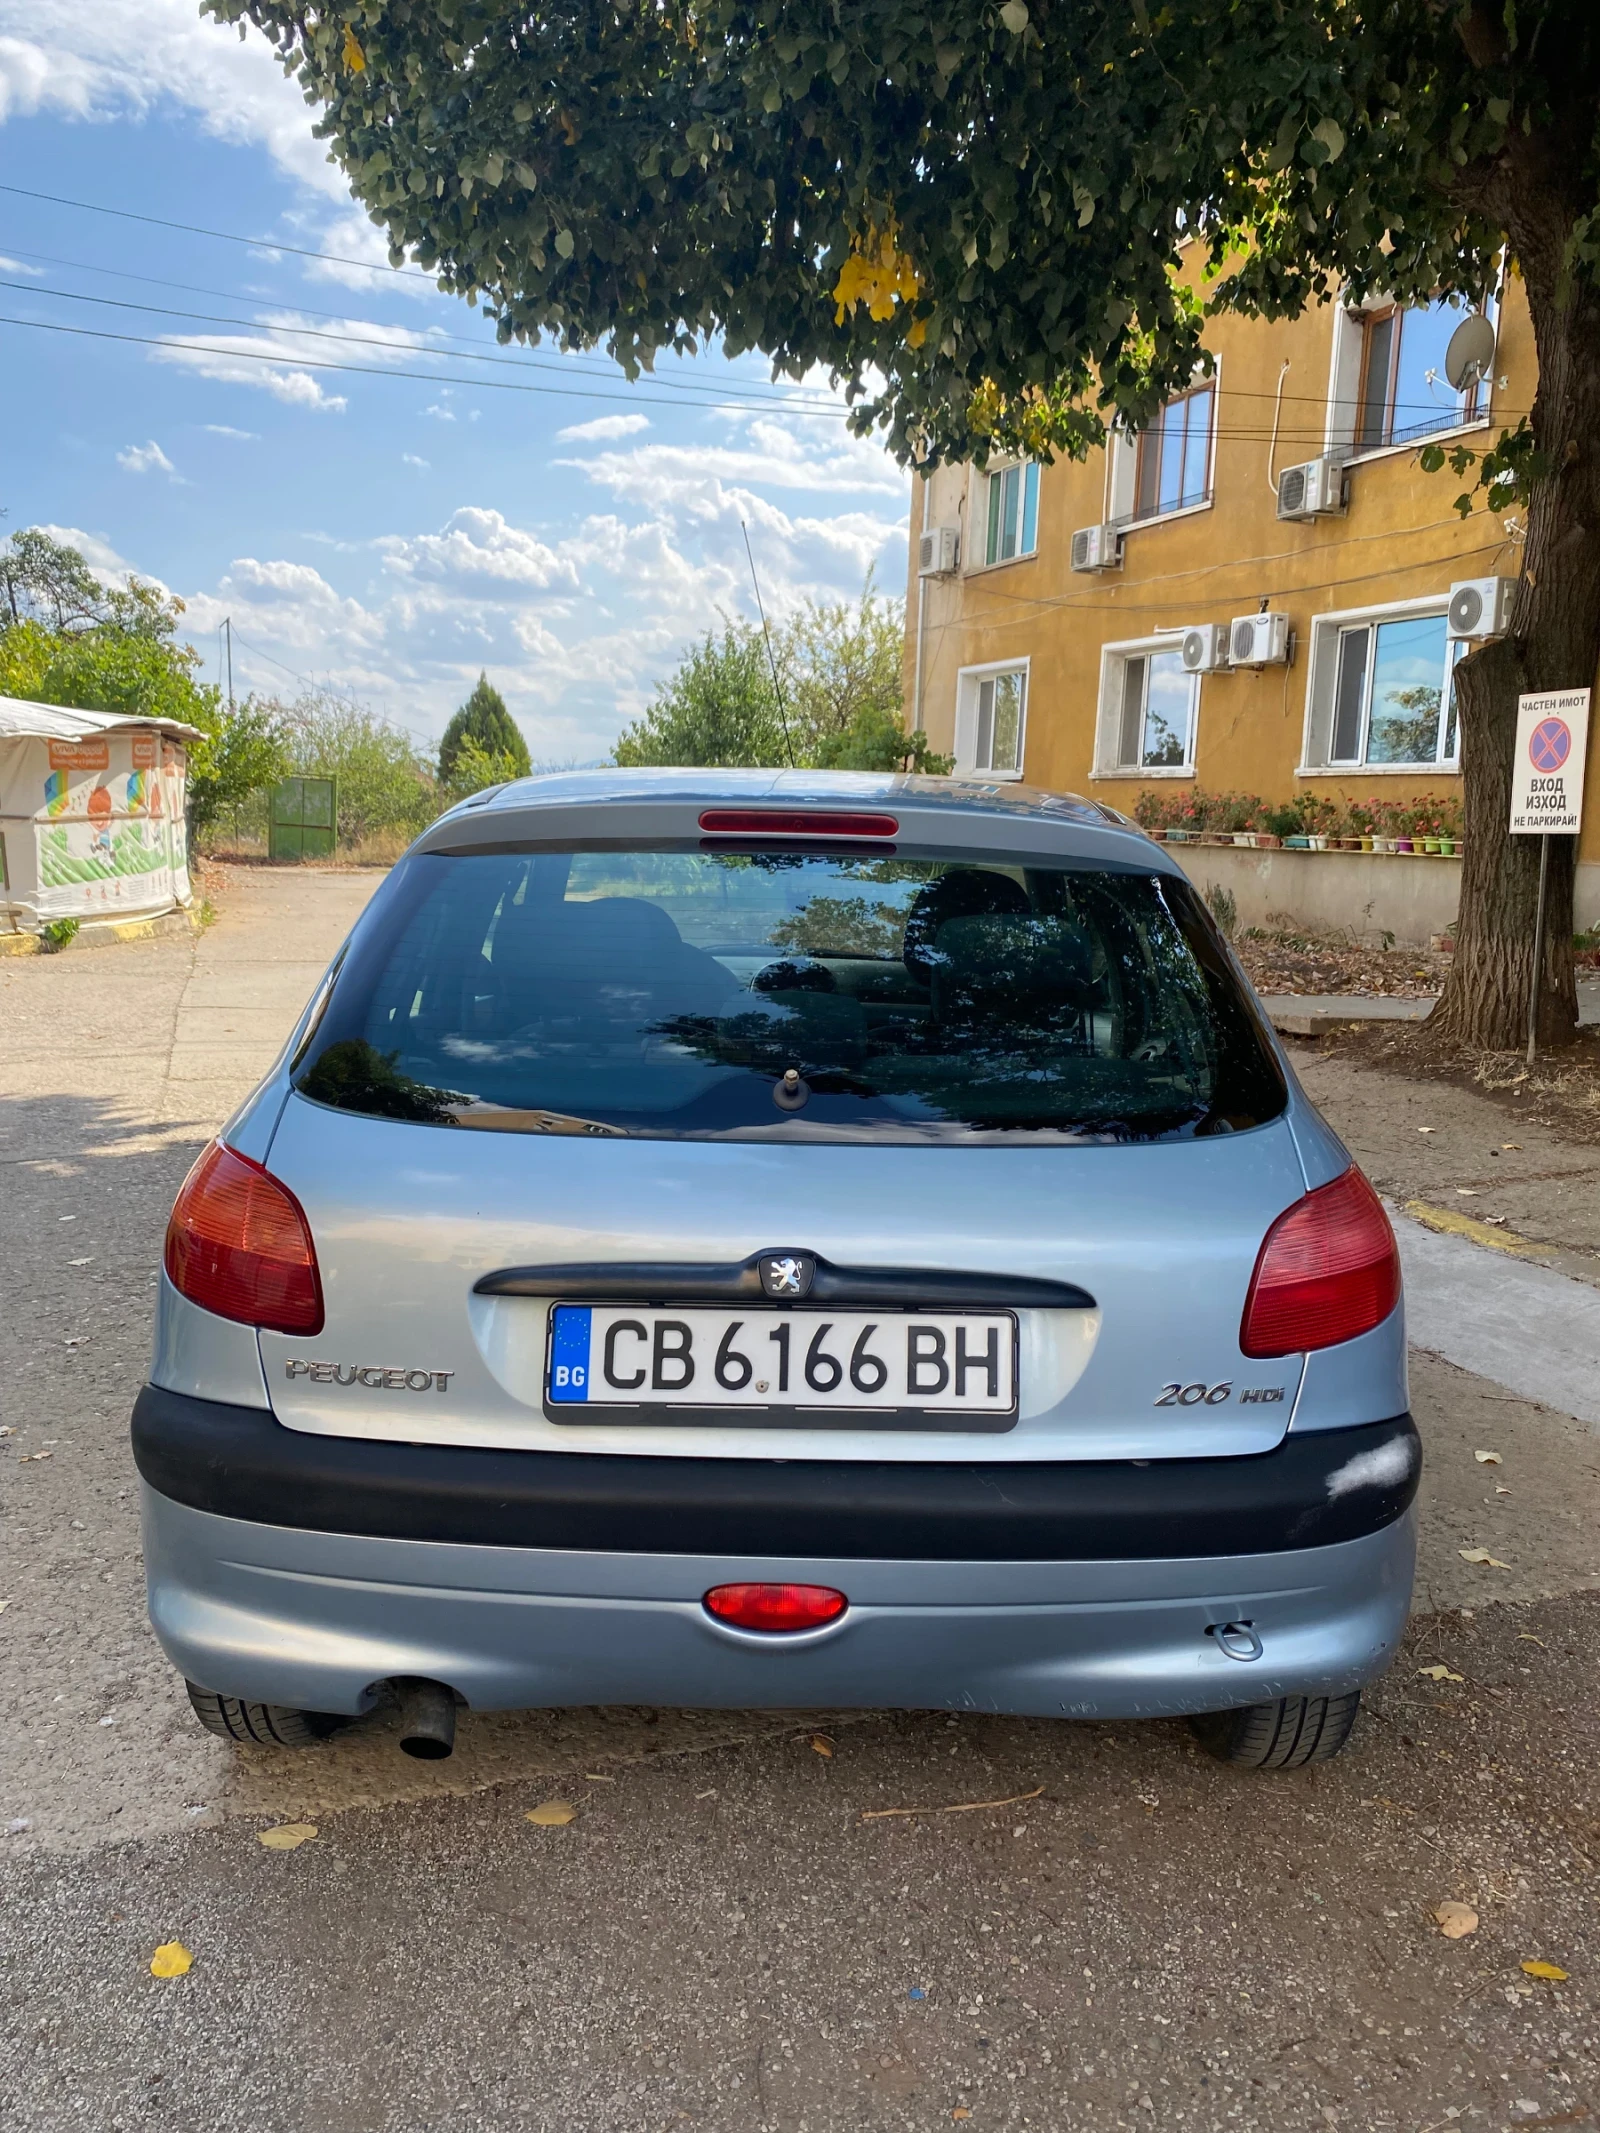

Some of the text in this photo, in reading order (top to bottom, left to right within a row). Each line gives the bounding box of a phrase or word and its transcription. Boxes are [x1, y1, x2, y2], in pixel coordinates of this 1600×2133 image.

[1521, 696, 1586, 711] ЧАСТЕН ИМОТ
[55, 745, 76, 753] VIVA
[1530, 777, 1564, 794] ВХОД
[1525, 795, 1567, 811] ИЗХОД
[1514, 813, 1577, 827] НЕ ПАРКИРАЙ!
[603, 1319, 998, 1397] CB 6166 BH
[285, 1357, 455, 1393] PEUGEOT
[555, 1365, 585, 1388] BG
[1153, 1380, 1286, 1407] 206 HDi
